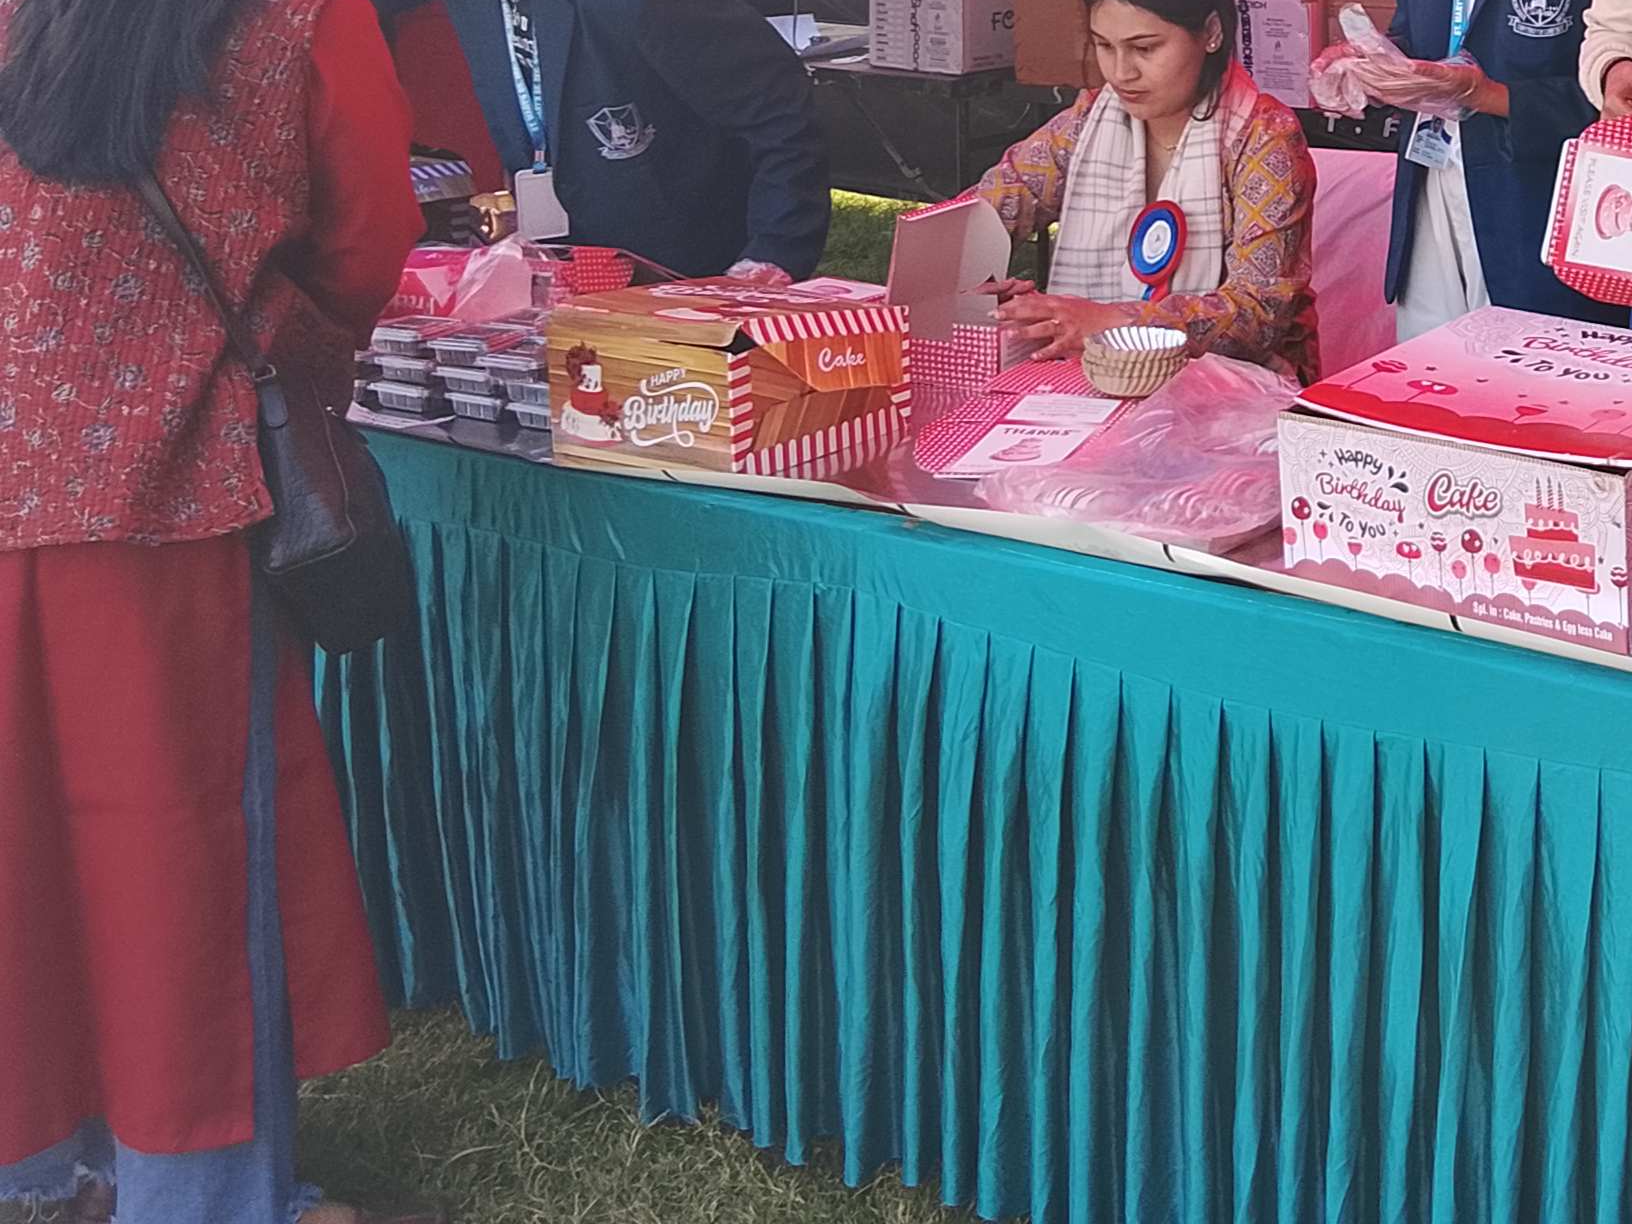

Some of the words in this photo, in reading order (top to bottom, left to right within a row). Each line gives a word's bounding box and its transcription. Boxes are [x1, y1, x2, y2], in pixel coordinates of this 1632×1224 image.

[817, 346, 867, 373] Cake
[1525, 360, 1554, 372] To
[1557, 367, 1610, 380] You
[650, 367, 688, 387] HAPPY
[623, 389, 718, 436] Birthday
[1334, 448, 1383, 475] Happy
[1316, 472, 1406, 523] Birthday
[1425, 470, 1501, 518] Cake
[1338, 512, 1354, 532] To
[1358, 519, 1386, 538] You
[1524, 612, 1553, 629] Pastries
[1563, 621, 1577, 636] Egg
[1578, 623, 1593, 637] less
[1594, 626, 1613, 641] Cake
